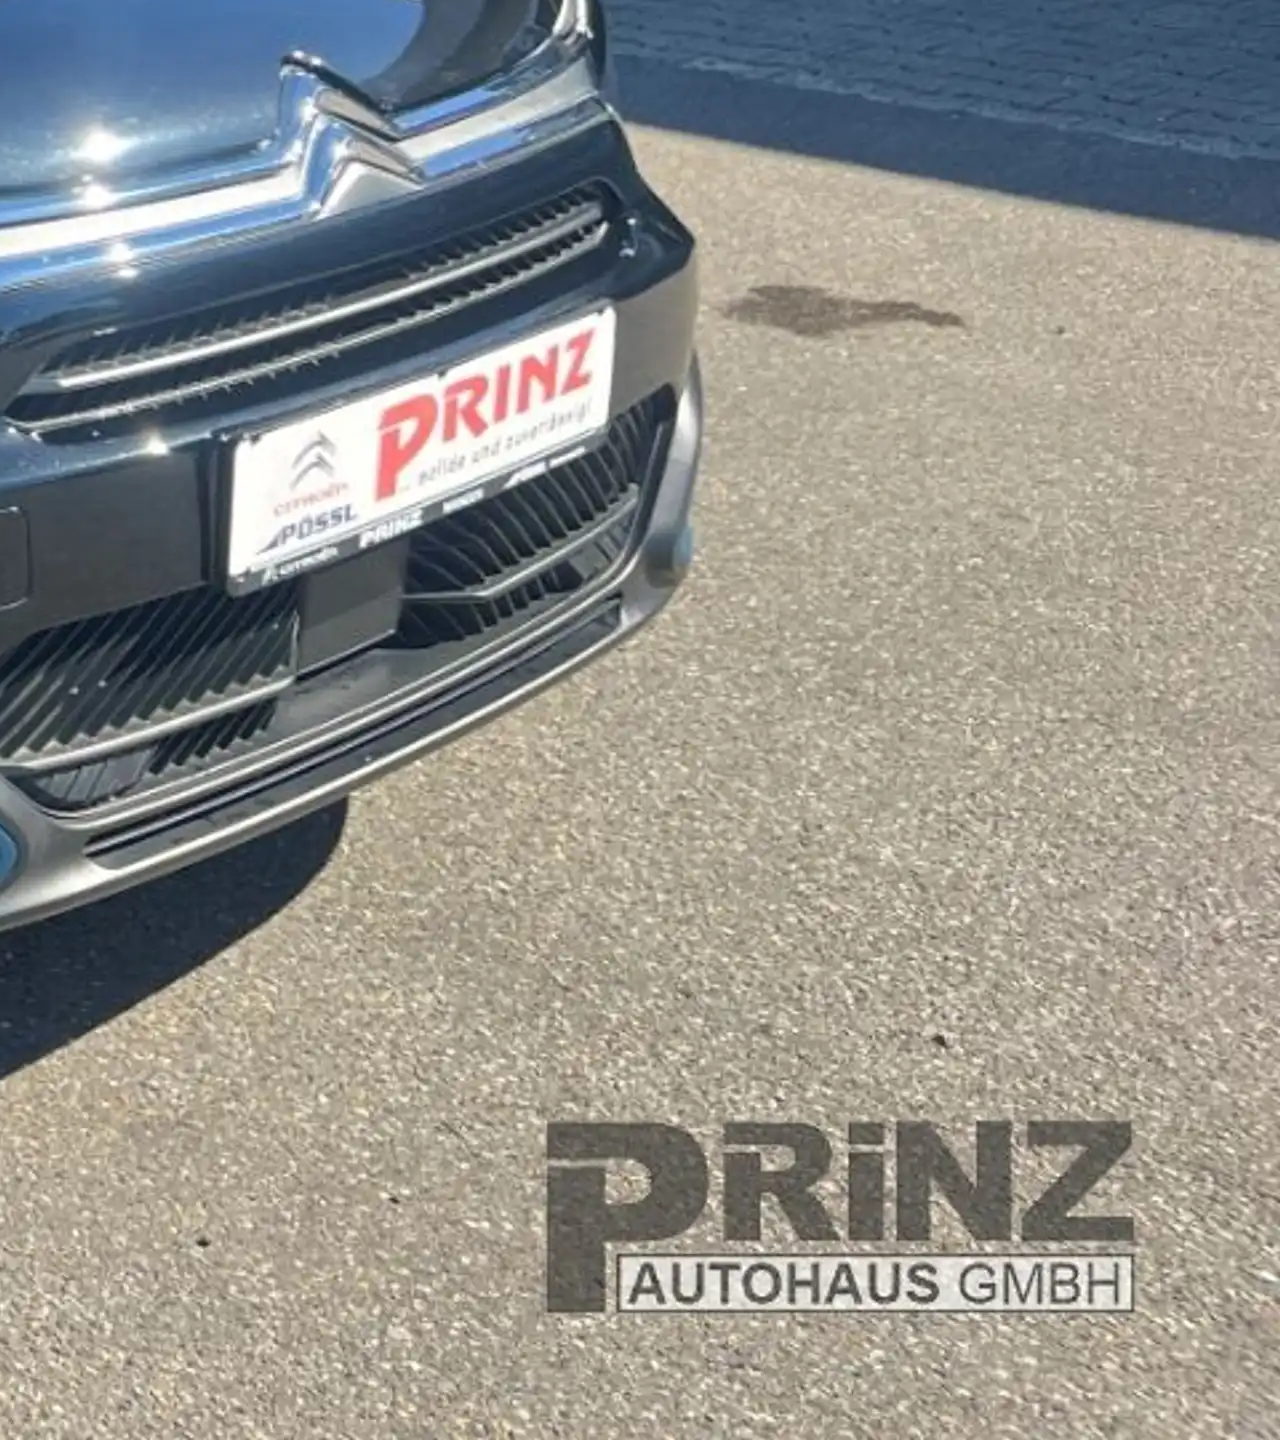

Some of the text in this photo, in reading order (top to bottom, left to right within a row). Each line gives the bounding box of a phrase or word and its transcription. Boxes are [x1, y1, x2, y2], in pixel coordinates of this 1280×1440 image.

[375, 328, 595, 502] PRINZ
[472, 440, 501, 462] und
[280, 503, 359, 545] PÖSSL
